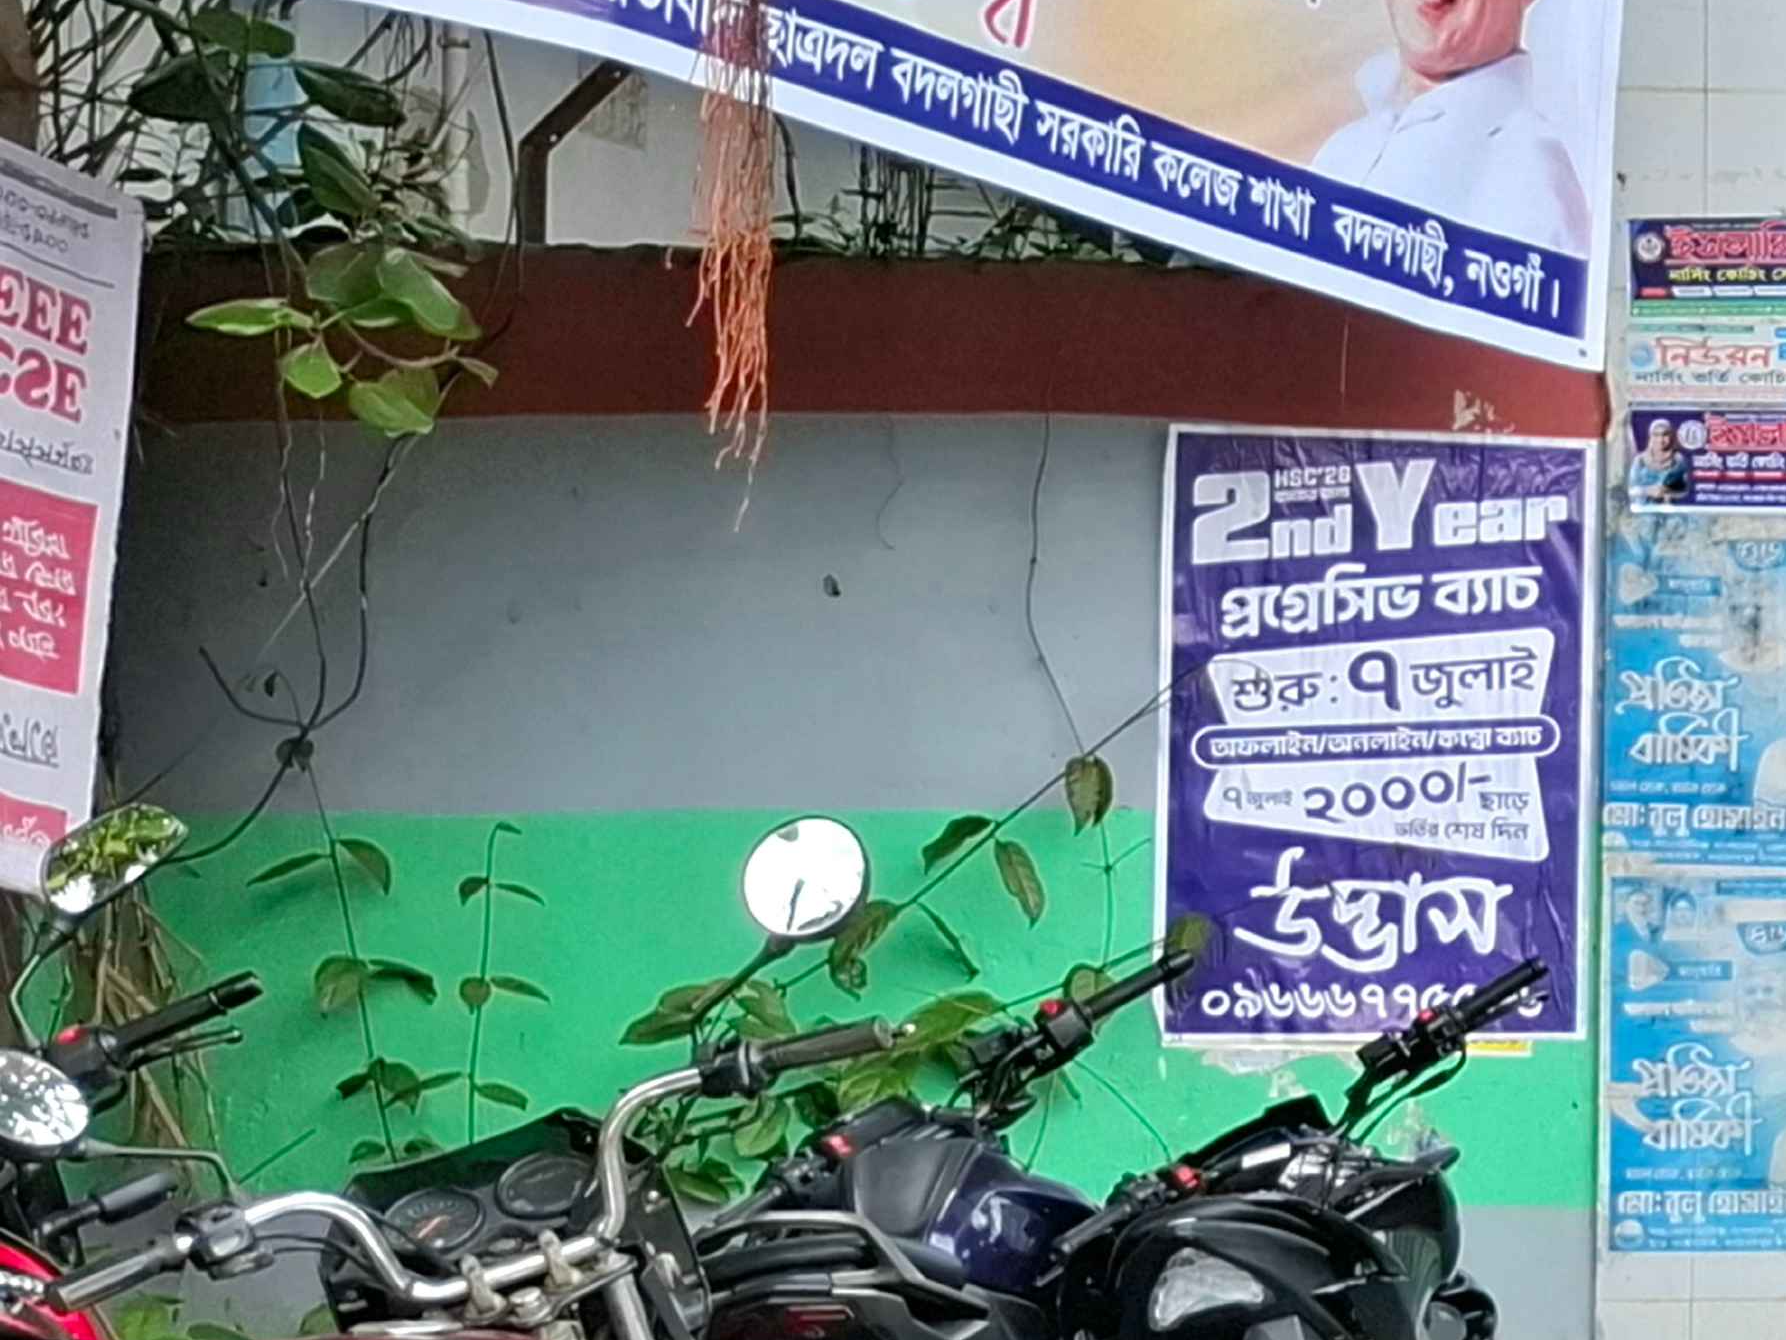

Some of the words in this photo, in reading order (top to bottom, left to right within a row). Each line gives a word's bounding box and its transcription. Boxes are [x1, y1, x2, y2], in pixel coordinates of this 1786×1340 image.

[762, 1, 883, 98] ছাত্রদল
[890, 45, 1031, 150] বদলগাছী
[1034, 105, 1147, 186] সরকারি
[1152, 139, 1245, 224] কলেজ
[1248, 173, 1317, 245] শাখা
[1192, 470, 1352, 565] 2nd
[1355, 457, 1569, 552] Year
[1221, 562, 1424, 640] প্রগ্রেসিভ
[1433, 565, 1545, 616] ব্যাচ
[1346, 649, 1402, 713] ৭
[1411, 646, 1540, 707] জুলাই
[1490, 817, 1530, 841] দিন
[1233, 846, 1514, 974] উদ্ভাস
